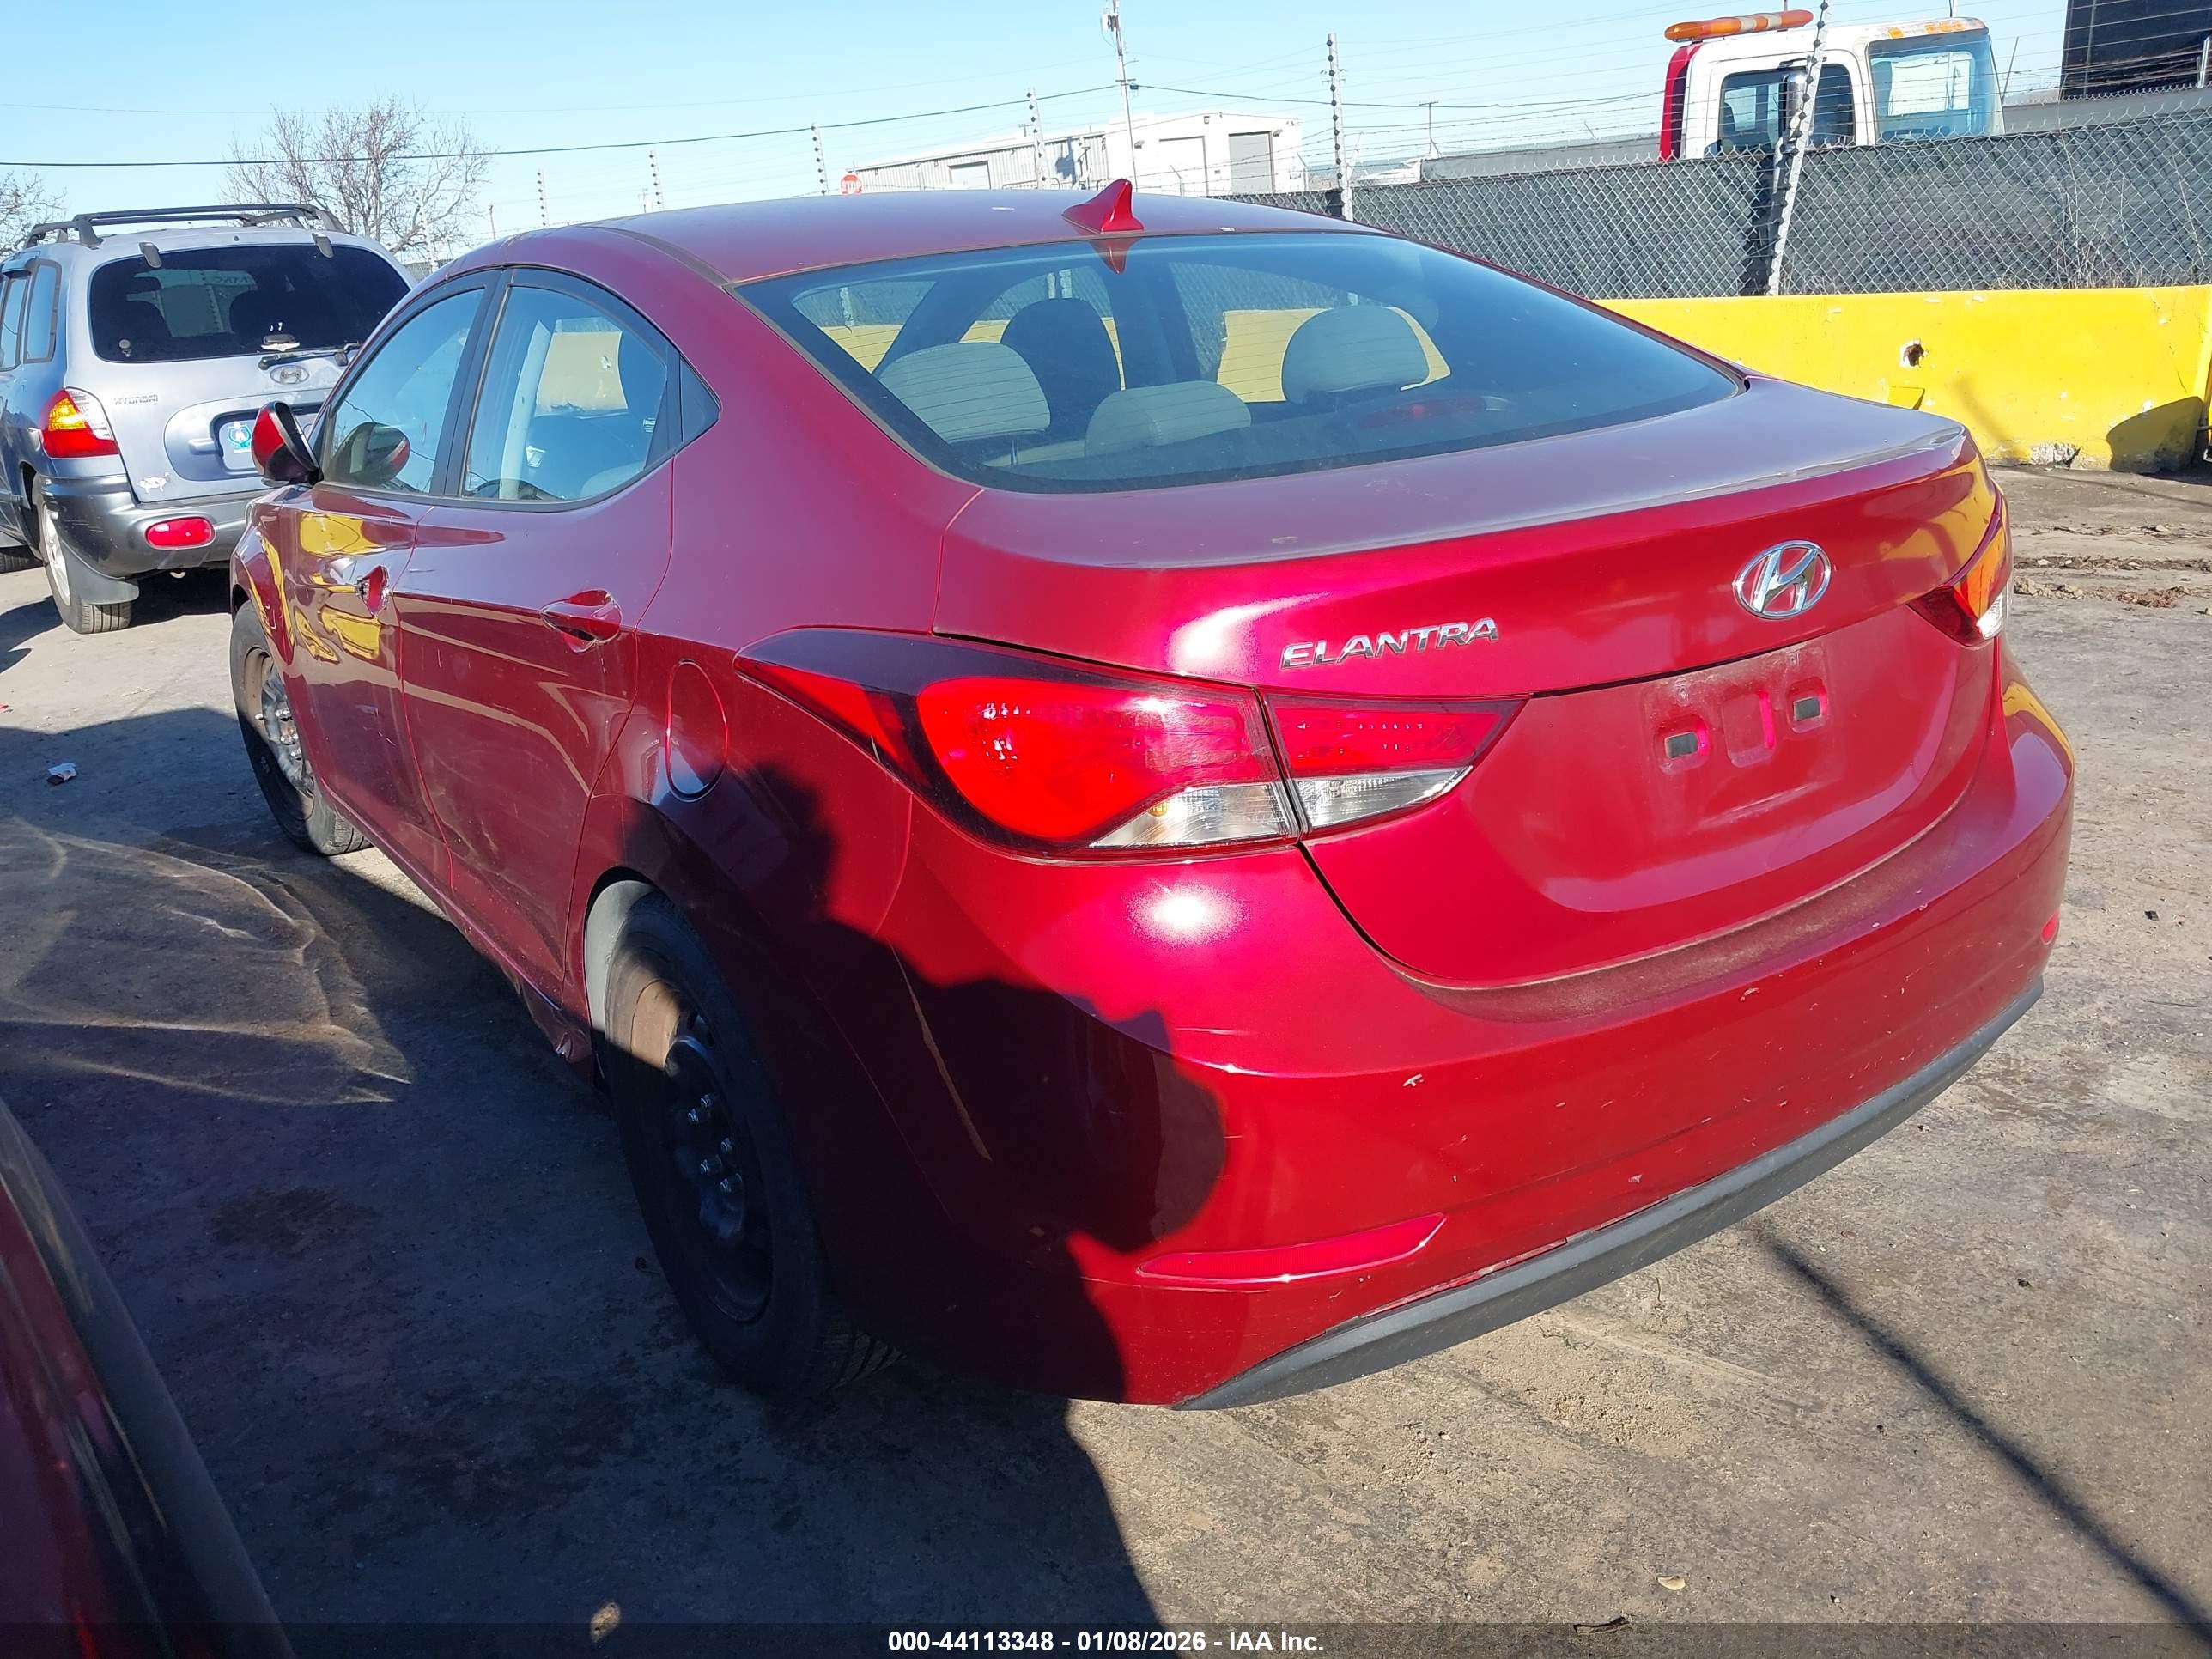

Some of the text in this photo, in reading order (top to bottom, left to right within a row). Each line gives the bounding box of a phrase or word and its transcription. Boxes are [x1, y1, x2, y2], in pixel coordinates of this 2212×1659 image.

[841, 179, 862, 193] STOP
[113, 393, 159, 405] HYUNDAI
[1280, 617, 1498, 670] ELANTRA
